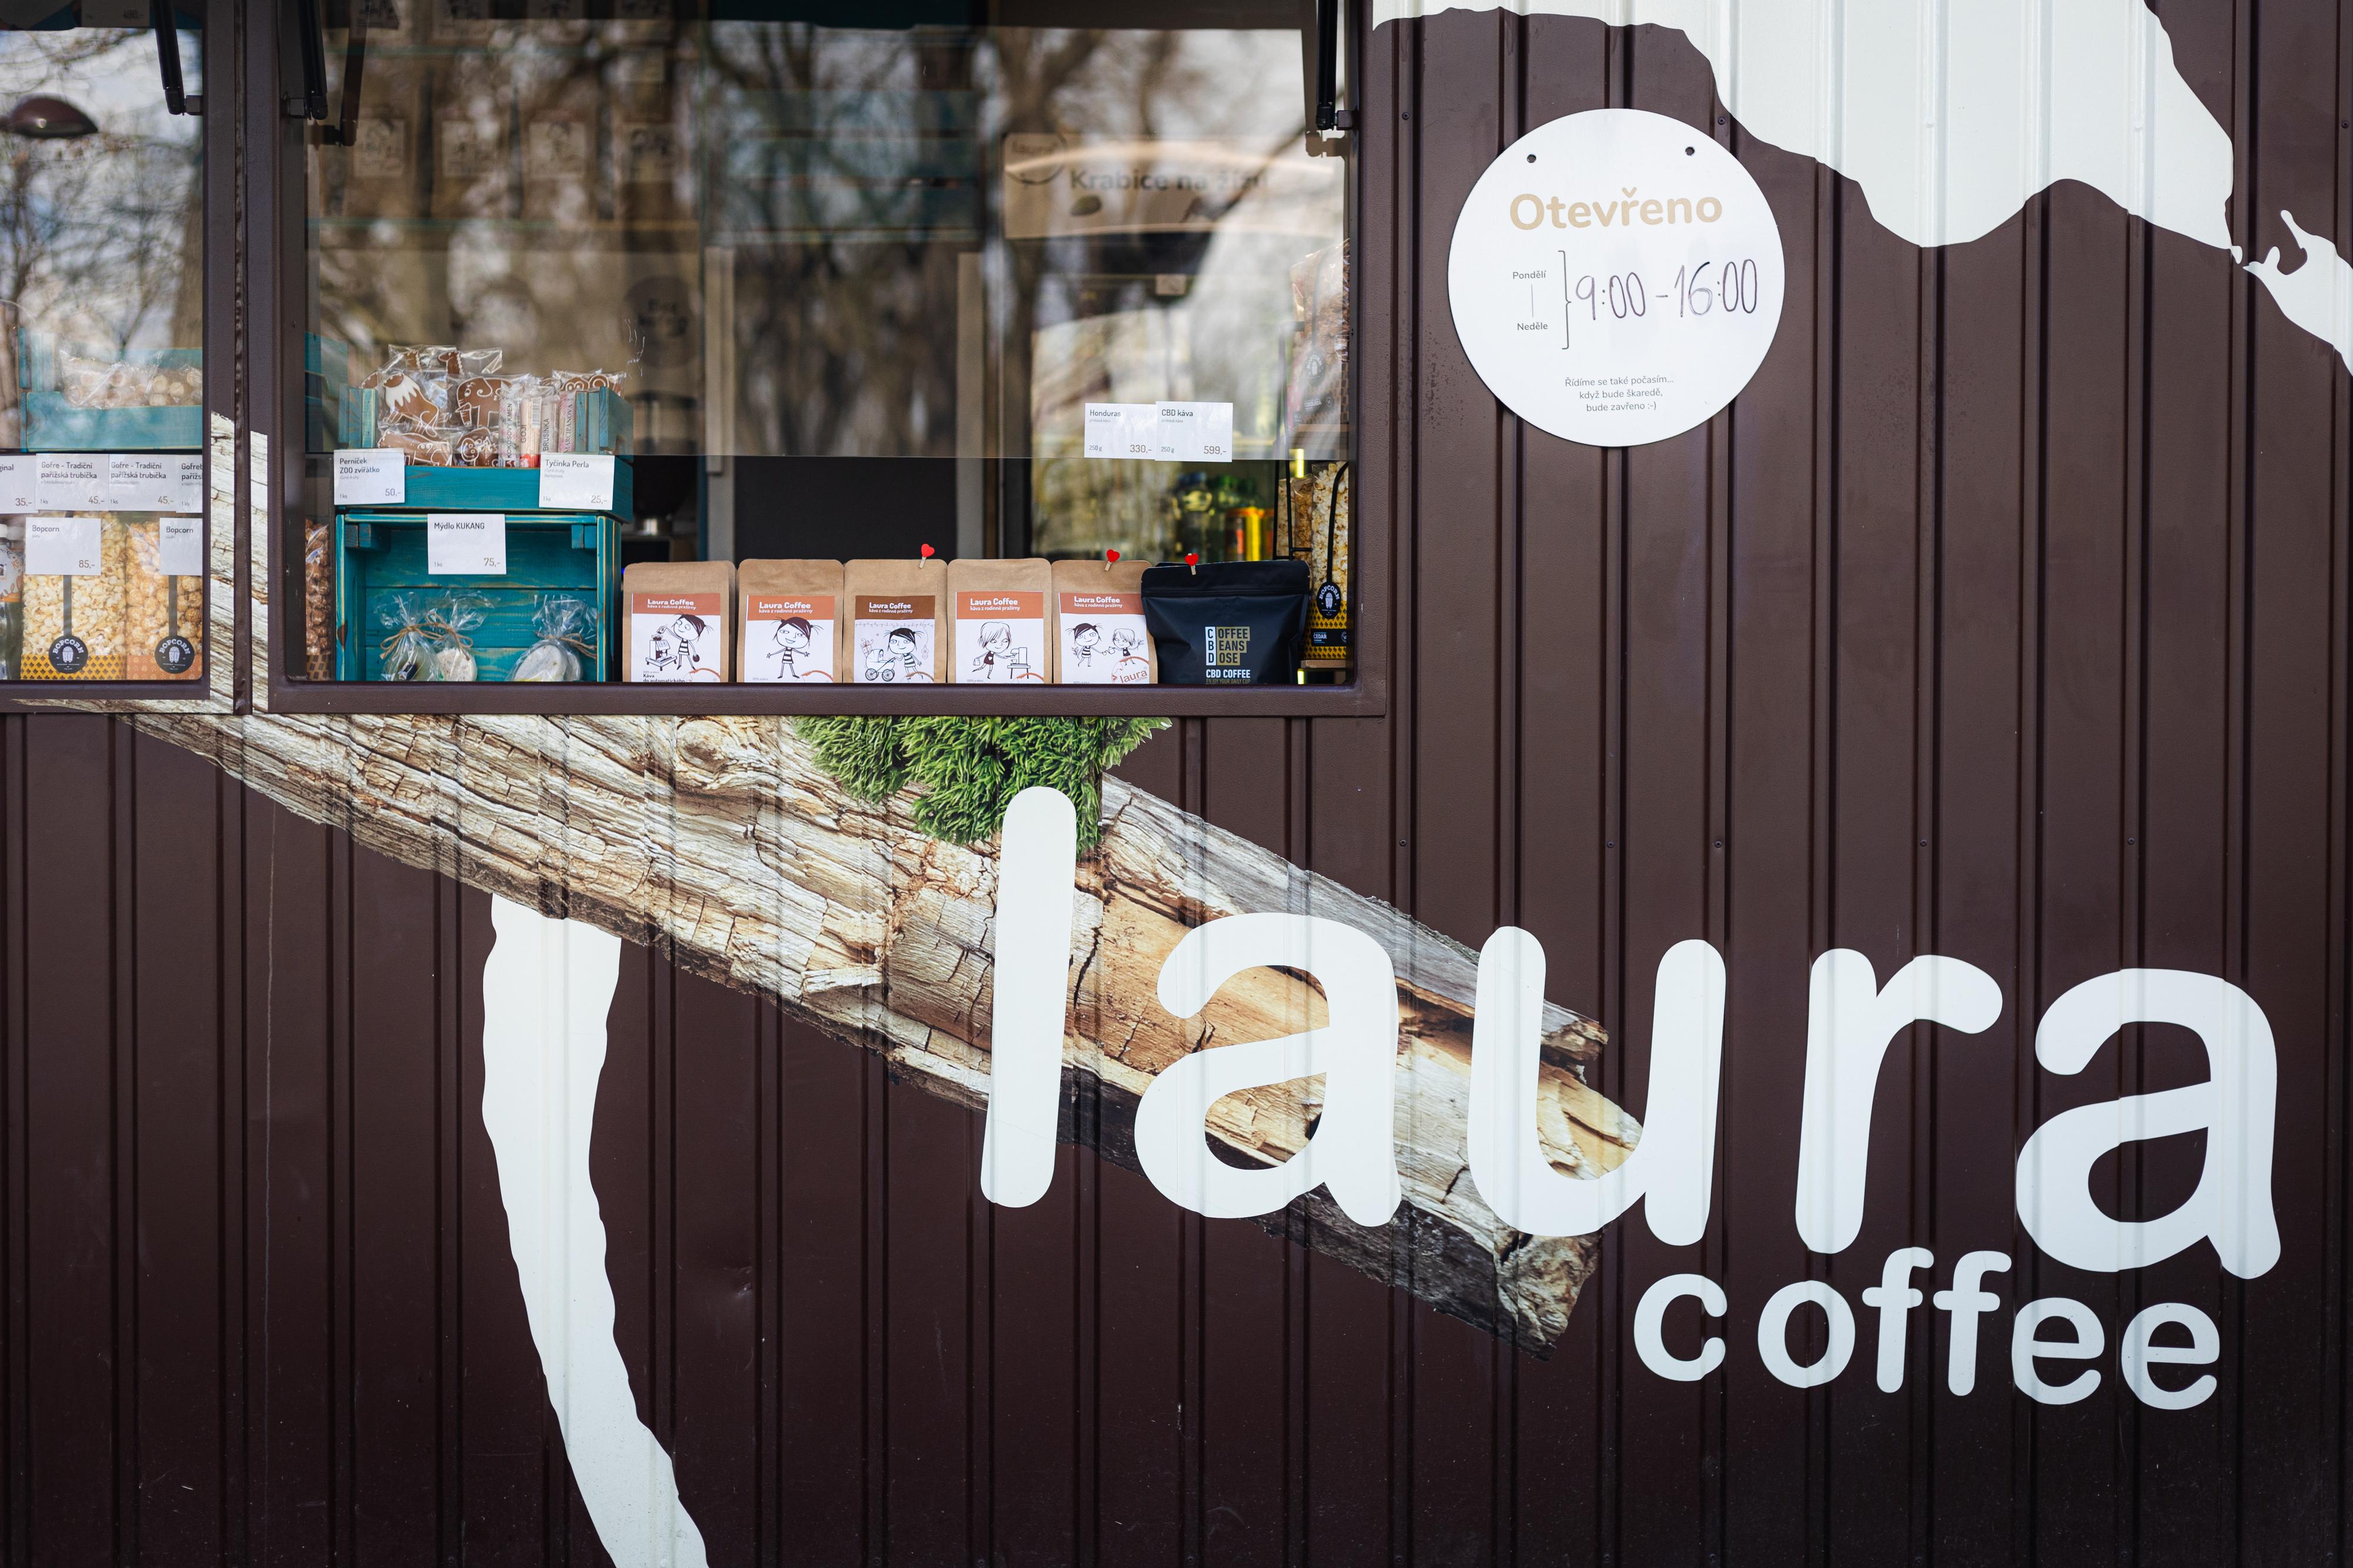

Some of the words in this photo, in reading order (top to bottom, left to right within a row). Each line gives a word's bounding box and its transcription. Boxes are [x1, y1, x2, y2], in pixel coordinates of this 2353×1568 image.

[1509, 187, 1722, 231] Otevřeno
[1512, 270, 1547, 279] Pondělí
[1517, 322, 1548, 331] Neděle
[1565, 377, 1595, 386] Řídíme
[1610, 376, 1628, 385] také
[1631, 375, 1674, 386] počasím...
[1579, 390, 1599, 400] když
[1602, 390, 1624, 398] bude
[1627, 388, 1663, 398] škaredě,
[1586, 403, 1608, 412] bude
[1611, 402, 1645, 411] zavřeno
[1129, 444, 1152, 453] 330,-
[1204, 446, 1227, 455] 599,-
[135, 461, 162, 469] Tradiční
[545, 459, 571, 468] Tyčinka
[41, 471, 69, 479] pařížská
[70, 471, 97, 479] trubička
[111, 471, 138, 479] pařížská
[181, 472, 203, 481] pařížs
[385, 488, 401, 496] 50,-
[15, 498, 32, 507] 35,-
[88, 496, 105, 505] 45,-
[158, 495, 174, 505] 45,-
[591, 495, 608, 504] 25,-
[32, 525, 59, 533] Bopcorn
[166, 526, 194, 535] Bopcorn
[434, 522, 454, 531] Mýdlo
[79, 560, 95, 569] 85,-
[484, 557, 501, 567] 75,-
[1319, 585, 1340, 600] BOPCORN
[52, 638, 84, 654] BOPCORN
[159, 638, 191, 655] BOPCORN
[1119, 670, 1148, 683] laura
[1206, 669, 1221, 678] CBD
[1223, 669, 1251, 678] COFFEE
[981, 786, 2281, 1279] laura
[1634, 1247, 2221, 1410] coffee
